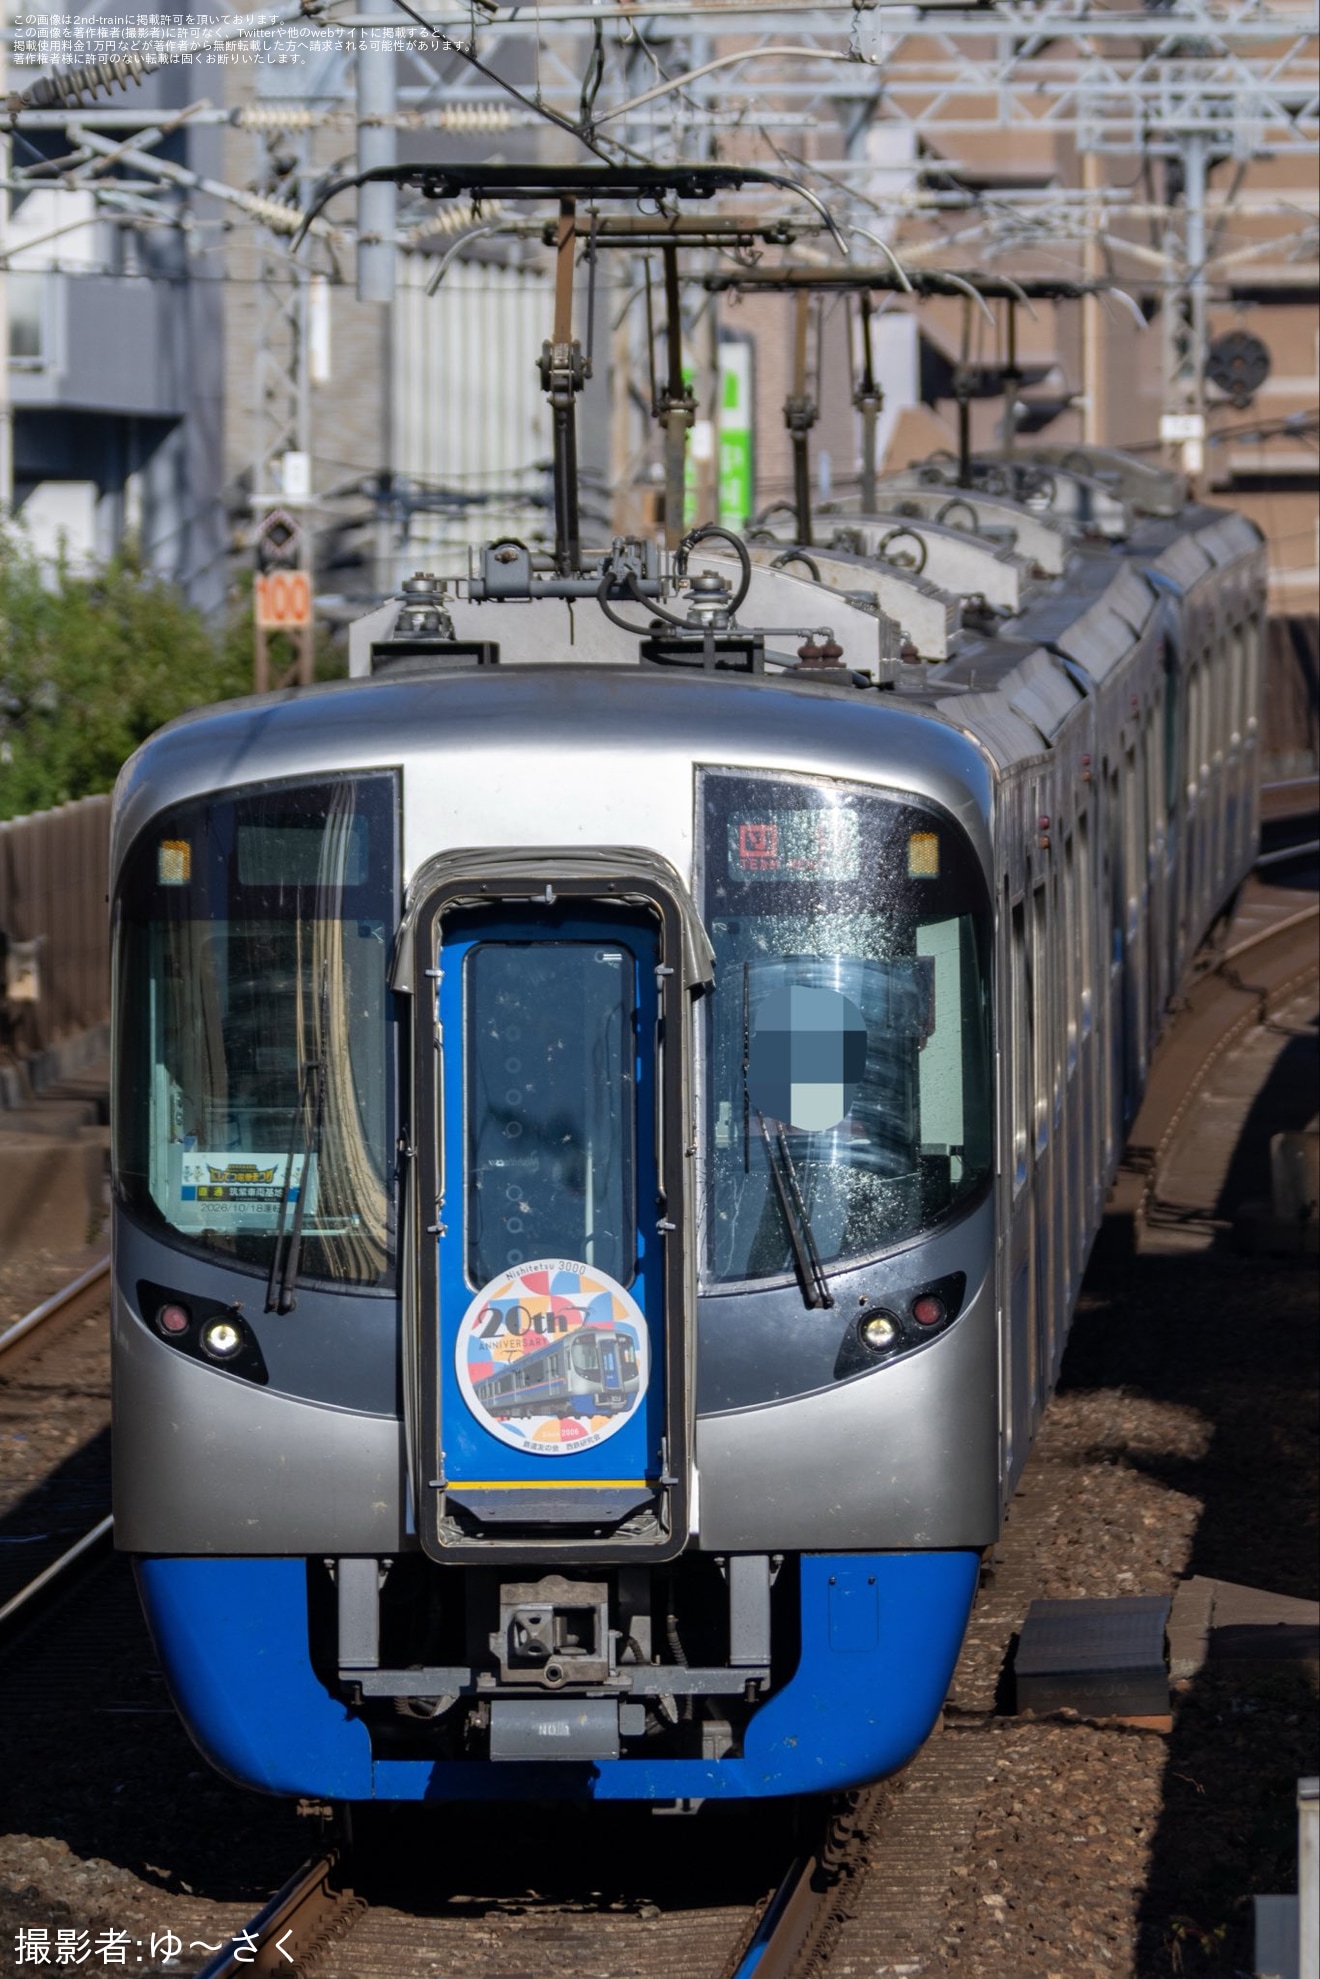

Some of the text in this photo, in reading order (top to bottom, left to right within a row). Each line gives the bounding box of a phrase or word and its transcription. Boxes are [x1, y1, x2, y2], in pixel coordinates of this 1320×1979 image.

[257, 574, 311, 622] 100
[506, 1261, 587, 1281] Nishitetsu 3000
[478, 1305, 568, 1339] 20th
[478, 1337, 549, 1351] ANNIVERSARY
[561, 1427, 579, 1437] 2006
